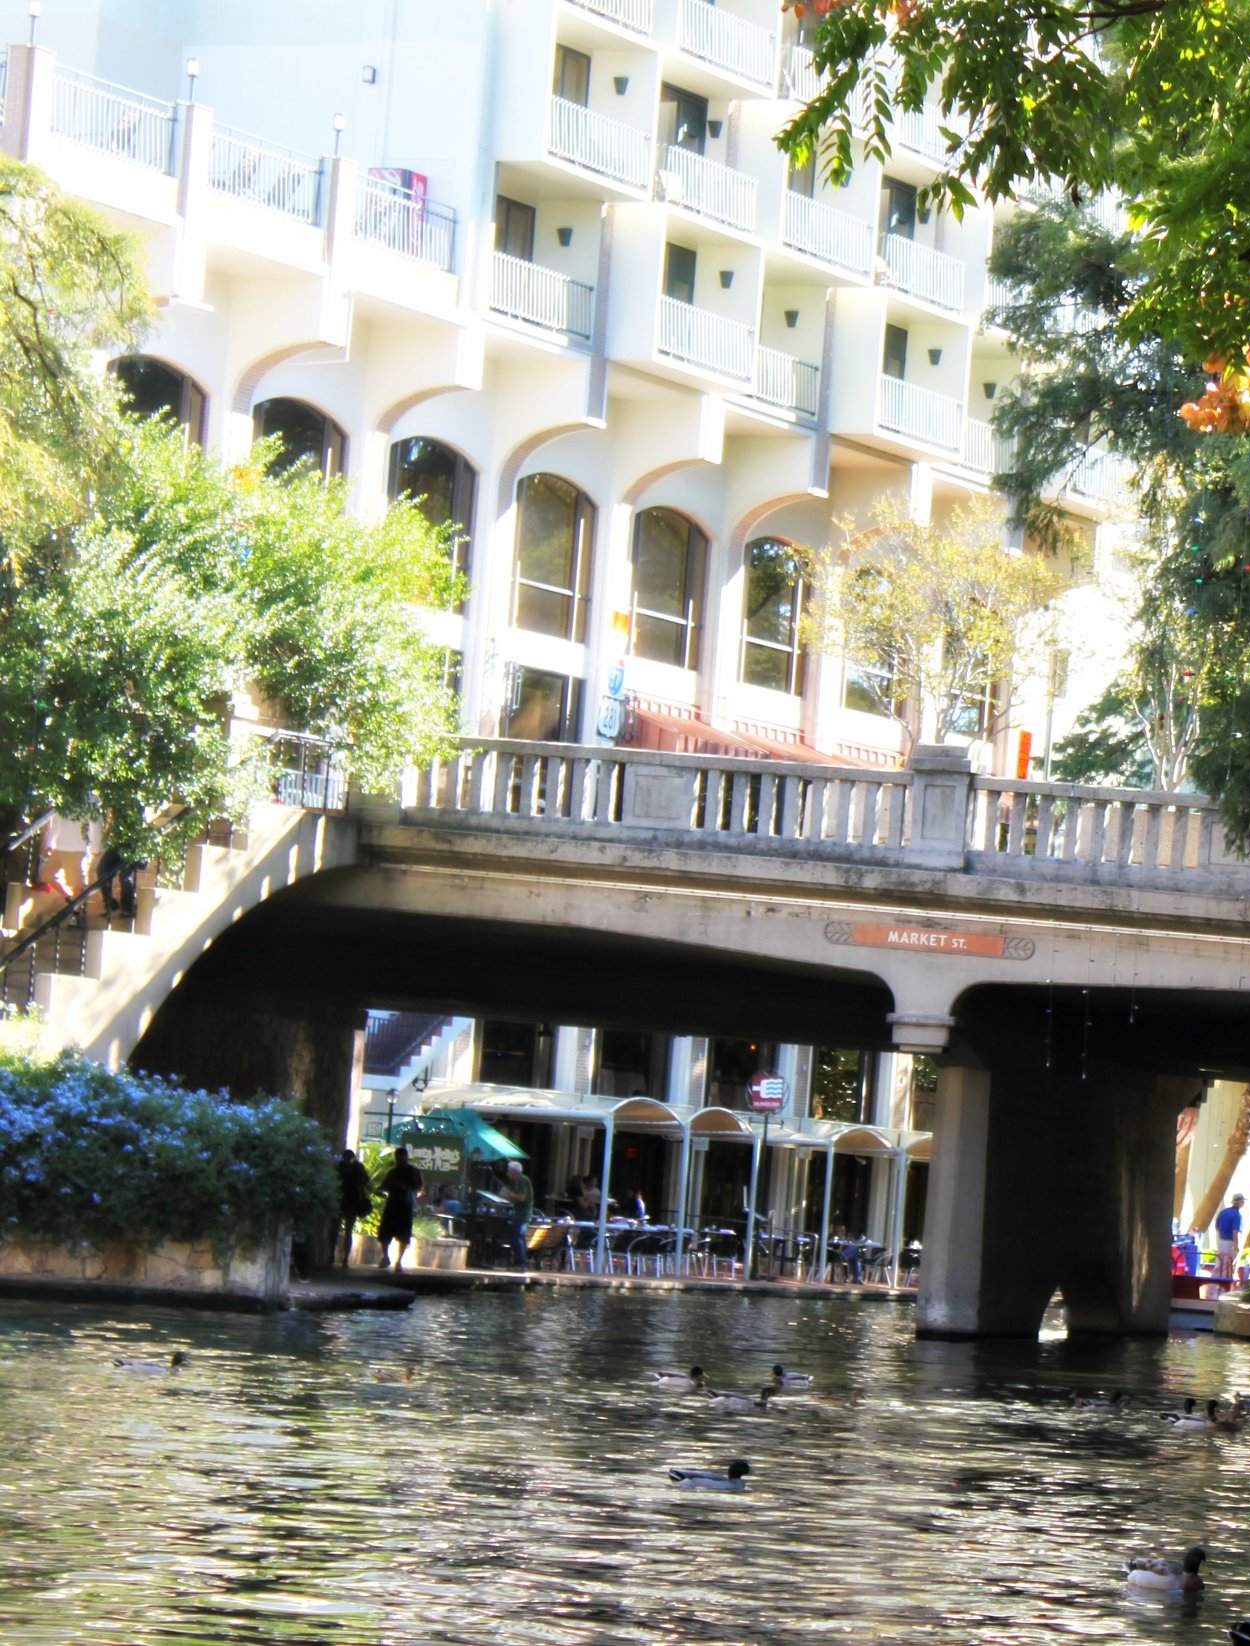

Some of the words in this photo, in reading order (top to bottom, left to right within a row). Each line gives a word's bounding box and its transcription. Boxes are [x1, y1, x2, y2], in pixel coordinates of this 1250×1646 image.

[603, 706, 617, 729] 281
[888, 930, 948, 948] MARKET
[951, 938, 968, 949] ST.
